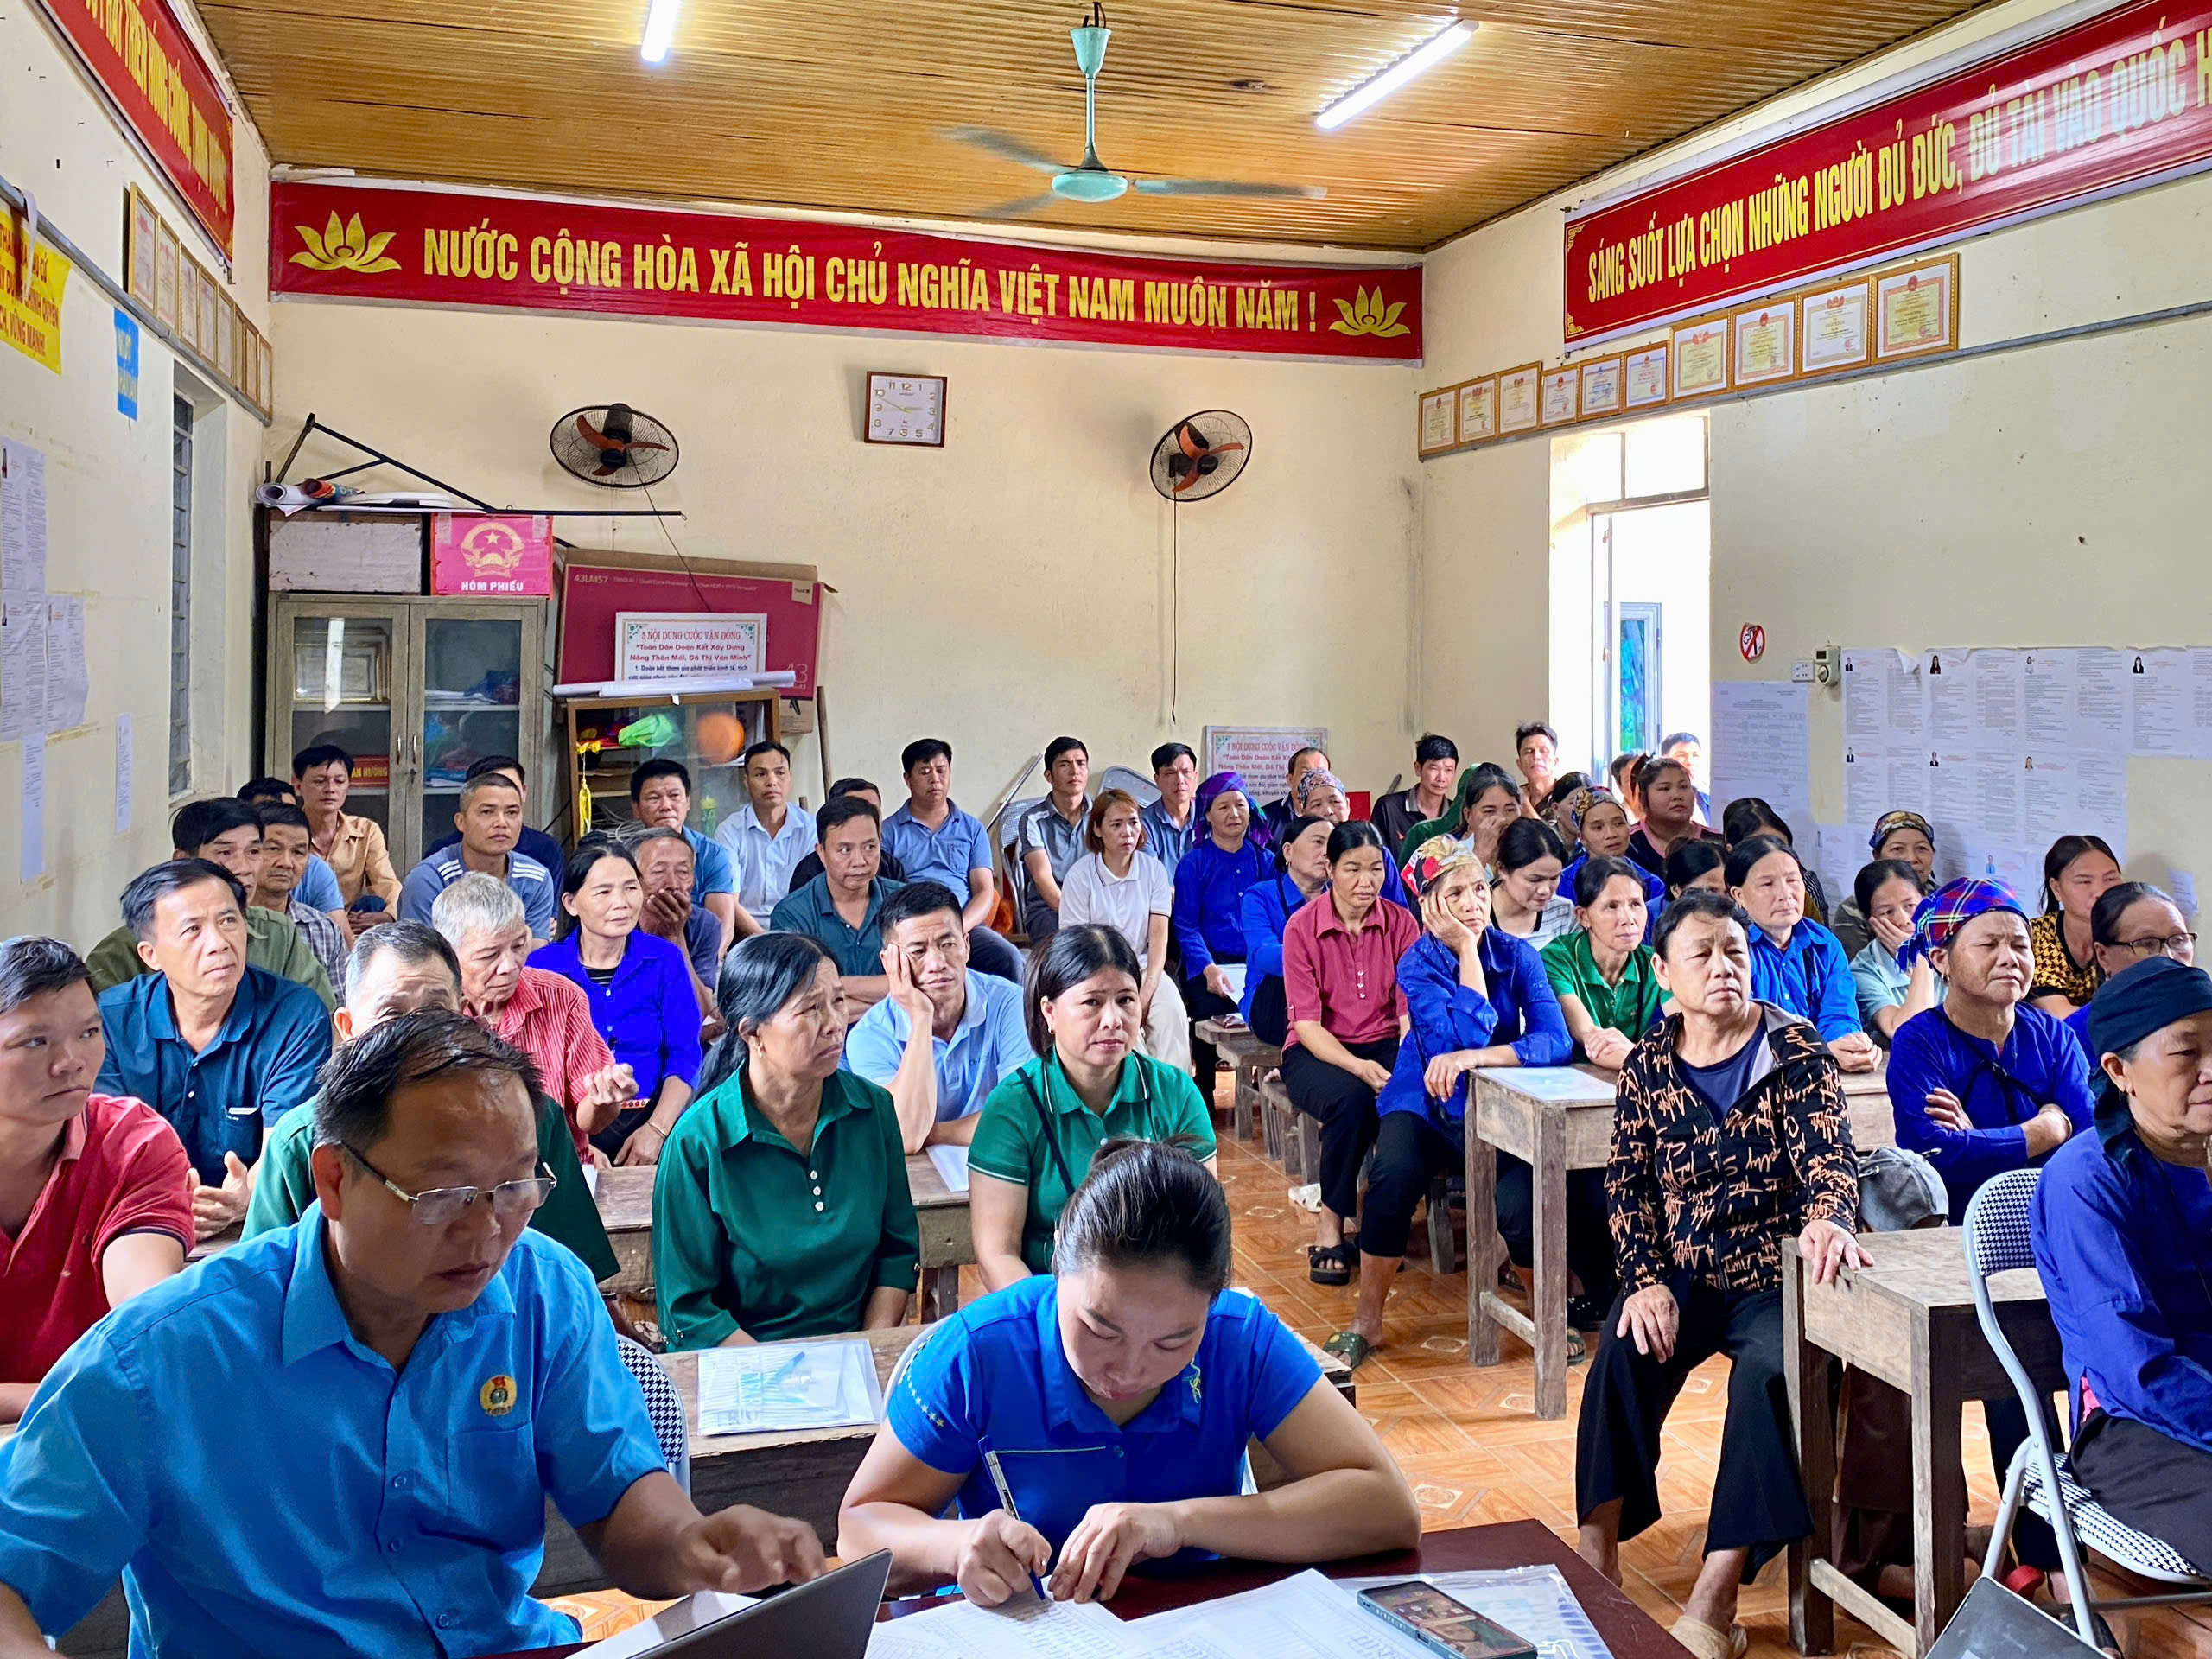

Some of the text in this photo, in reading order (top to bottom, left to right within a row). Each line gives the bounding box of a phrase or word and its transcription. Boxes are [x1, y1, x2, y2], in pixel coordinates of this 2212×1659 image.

[1588, 238, 1624, 303] SÁNG
[1628, 211, 1663, 291] SUỐT
[1668, 213, 1696, 288] LỰA
[1700, 203, 1744, 273] CHỌN
[1748, 173, 1809, 252] NHỮNG
[1814, 139, 1872, 232] NGƯỜI
[1878, 118, 1906, 210] ĐỦ
[1911, 114, 1963, 194] ĐỨC,
[1969, 84, 2001, 181] ĐỦ
[2006, 79, 2046, 168] TÀI
[2052, 61, 2101, 153] VÀO
[2110, 16, 2187, 142] QUỐC
[423, 219, 1316, 332] NƯỚC CỘNG HÒA XÃ HỘI CHỦ NGHĨA VIỆT NAM MUÔN NĂM !
[490, 580, 524, 591] PHIẾU
[648, 629, 660, 642] NỘI
[663, 631, 683, 640] DUNG
[684, 629, 703, 642] CUỘC
